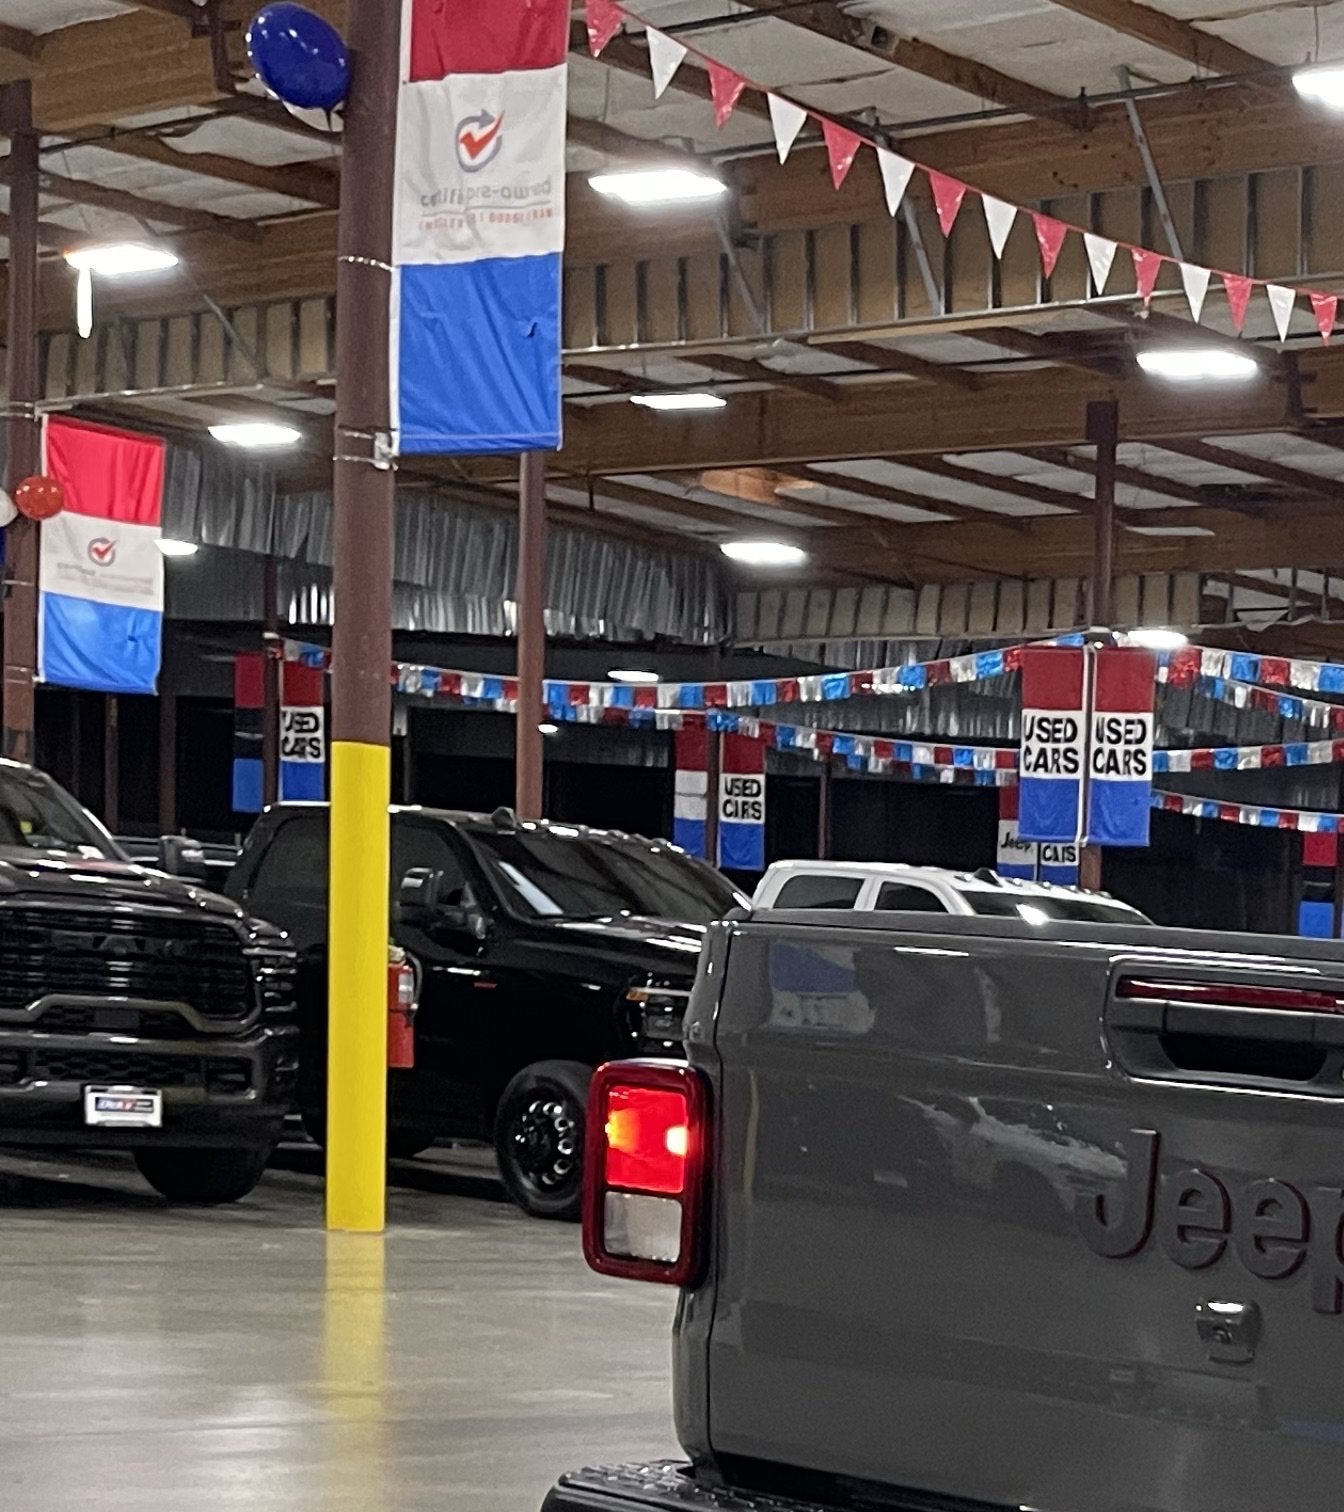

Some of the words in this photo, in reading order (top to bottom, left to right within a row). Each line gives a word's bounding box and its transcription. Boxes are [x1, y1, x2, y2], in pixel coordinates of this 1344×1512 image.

[1024, 715, 1079, 744] USED
[1095, 716, 1147, 745] USED
[1023, 745, 1080, 775] CARS
[1092, 746, 1147, 776] CARS
[725, 777, 762, 798] USED
